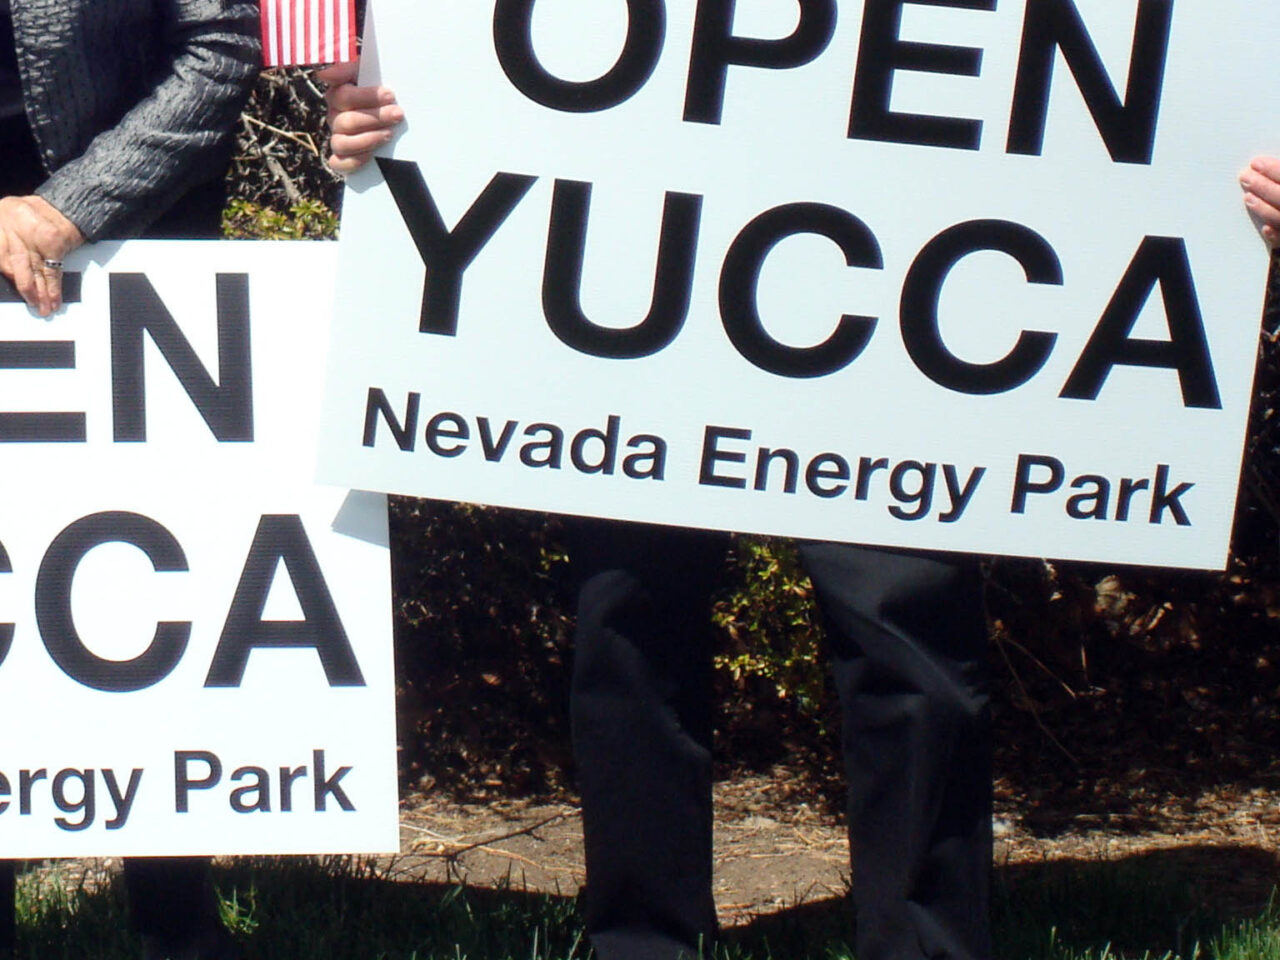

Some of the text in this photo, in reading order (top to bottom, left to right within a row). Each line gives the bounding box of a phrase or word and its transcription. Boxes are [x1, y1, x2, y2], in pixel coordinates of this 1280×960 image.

[375, 157, 1223, 410] YUCCA
[362, 387, 1196, 527] Nevada Energy Park
[173, 750, 357, 815] Park
